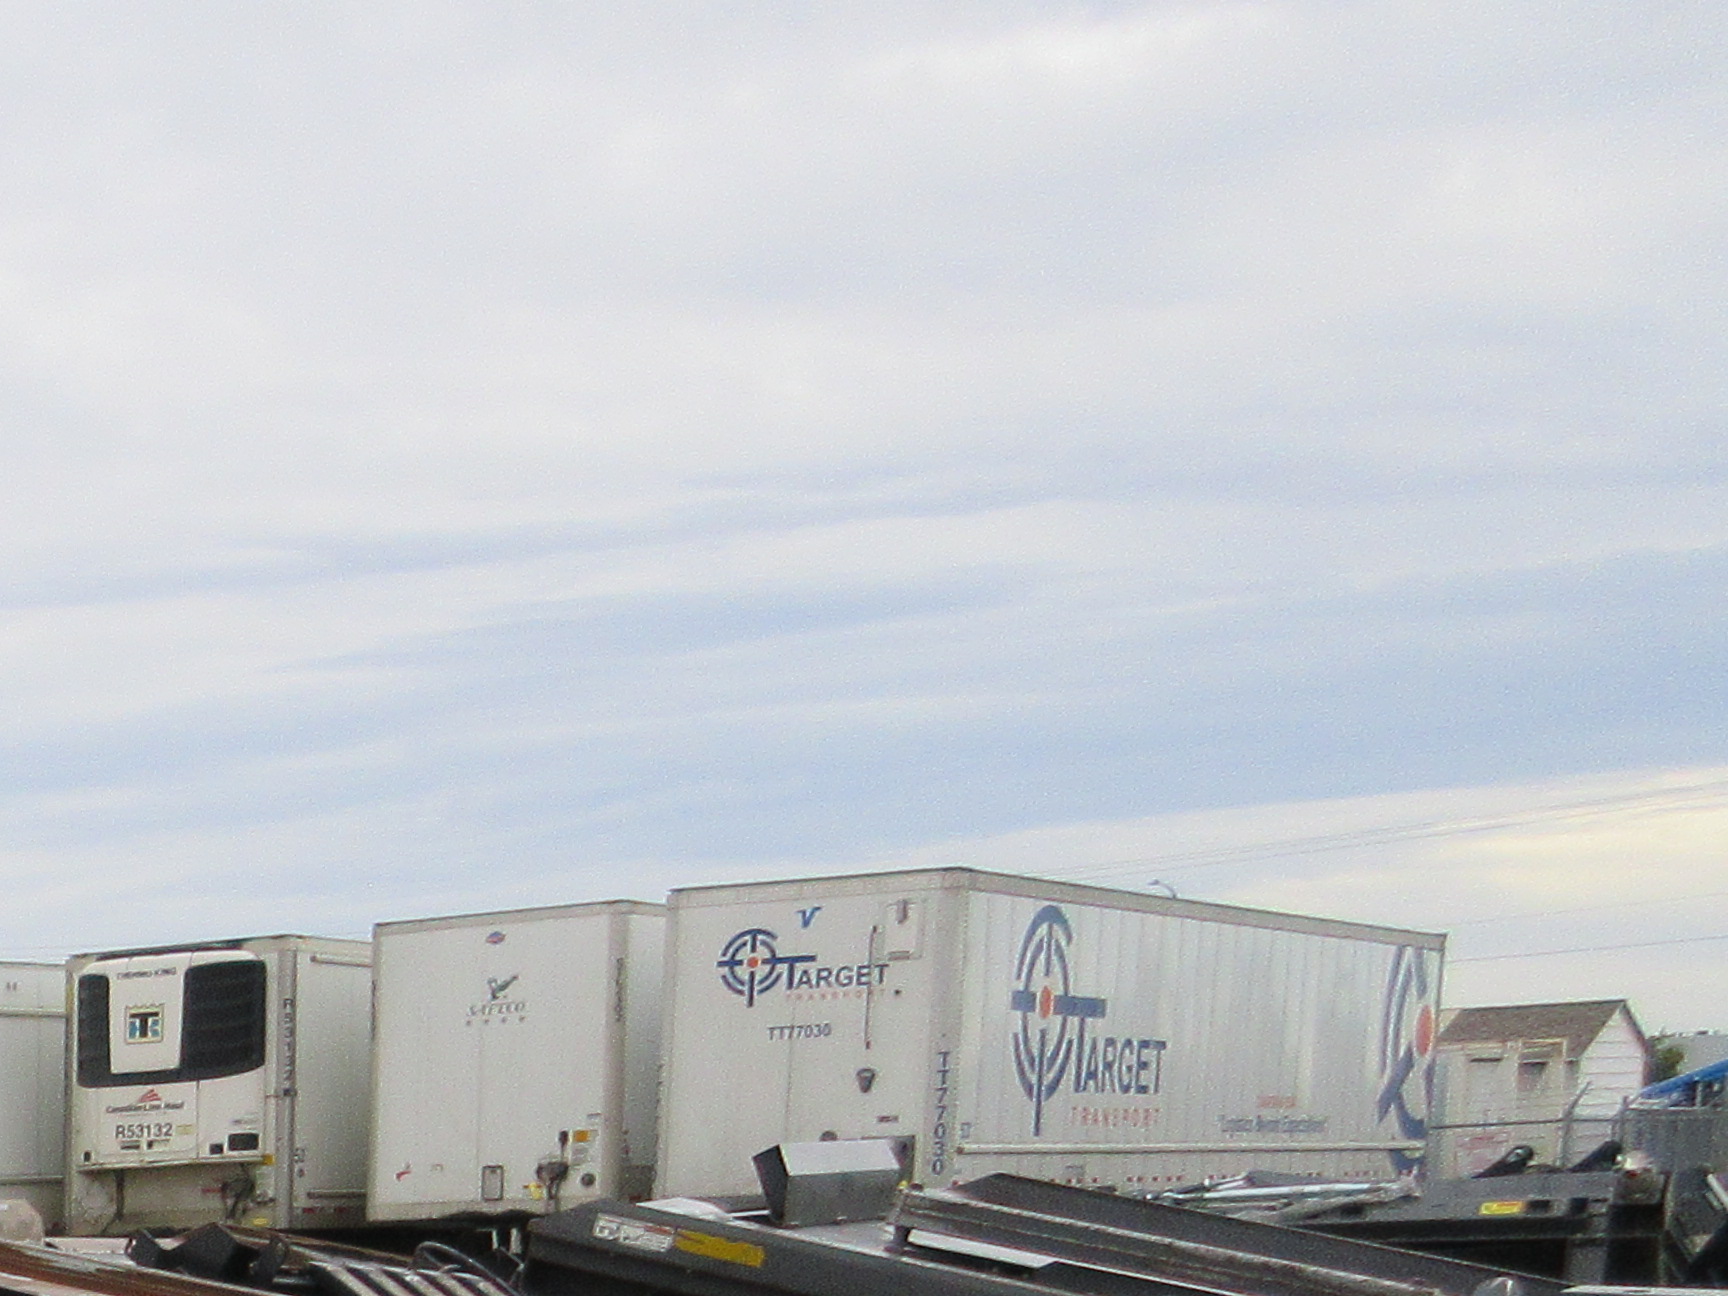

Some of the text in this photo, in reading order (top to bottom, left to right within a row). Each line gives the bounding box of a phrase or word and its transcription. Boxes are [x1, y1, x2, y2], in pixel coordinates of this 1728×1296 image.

[778, 954, 890, 990] TARGET
[767, 1023, 833, 1041] TT77030
[1054, 997, 1167, 1095] TARGET
[115, 1122, 173, 1140] R53132
